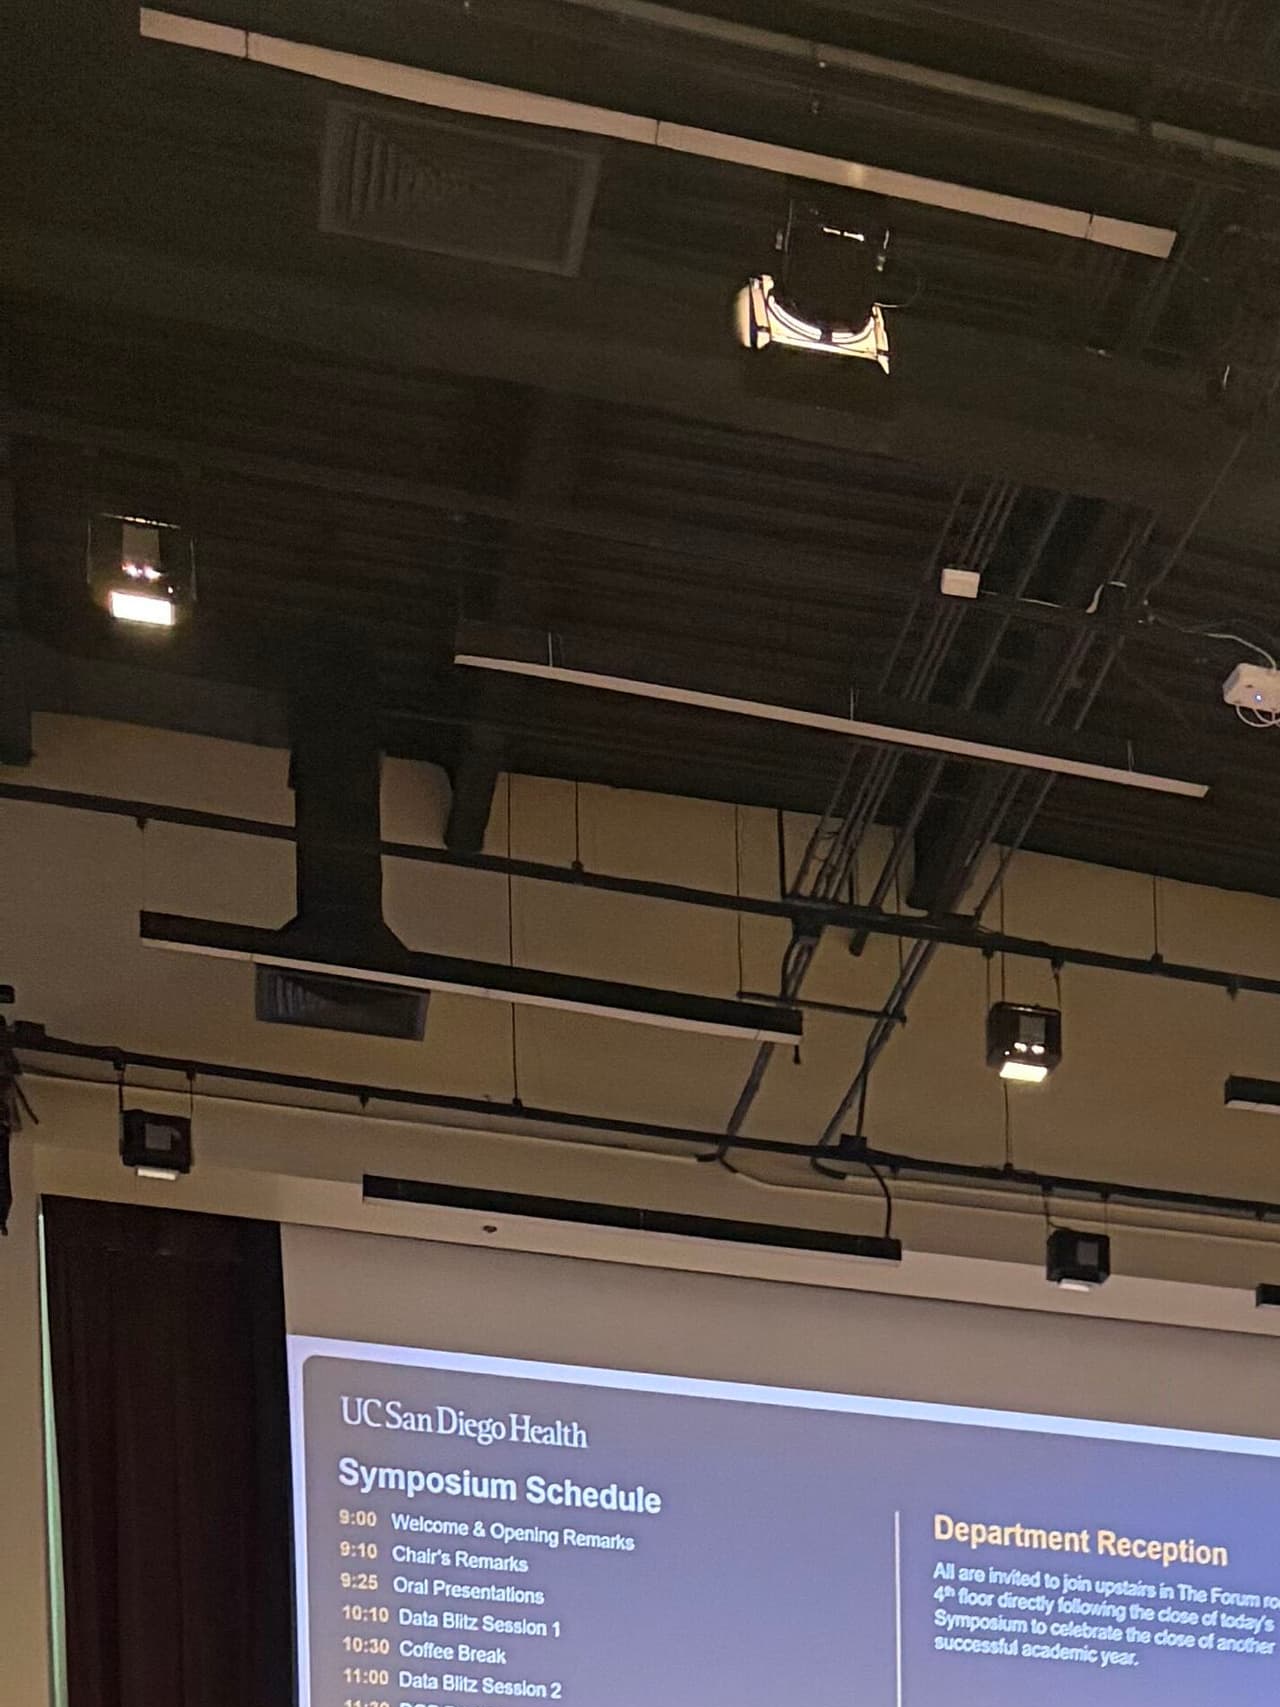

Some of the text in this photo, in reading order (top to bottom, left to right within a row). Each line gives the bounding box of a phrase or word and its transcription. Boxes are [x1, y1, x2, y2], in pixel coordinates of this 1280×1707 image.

[342, 1396, 589, 1448] UC San Diego Health
[339, 1457, 662, 1514] Symposium Schedule
[339, 1509, 635, 1551] 9:00 Welcome & Opening Remarks
[934, 1514, 1228, 1567] Department Reception
[339, 1541, 528, 1573] 9:10 Chair's Remarks
[340, 1572, 545, 1605] 9:25 Oral Presentations
[933, 1562, 955, 1580] All
[959, 1566, 985, 1583] are
[989, 1567, 1040, 1588] invited
[1044, 1573, 1060, 1589] to
[1062, 1574, 1092, 1594] join
[1095, 1580, 1156, 1598] upstairs
[1159, 1583, 1175, 1600] in
[1177, 1584, 1207, 1603] The
[1211, 1588, 1260, 1608] Forum
[342, 1605, 560, 1638] 10:10 Data Blitz Session 1
[958, 1587, 994, 1606] floor
[998, 1592, 1054, 1615] directly
[1058, 1597, 1126, 1622] following
[1129, 1603, 1155, 1621] the
[1158, 1607, 1199, 1625] close
[1202, 1610, 1219, 1626] of
[1220, 1613, 1276, 1634] today's
[342, 1637, 507, 1664] 10:30 Coffee Break
[934, 1609, 1276, 1655] Symposium to celebrate the close of another
[934, 1636, 1139, 1667] successful academic year.
[343, 1668, 562, 1700] 11:00 Data Blitz Session 2
